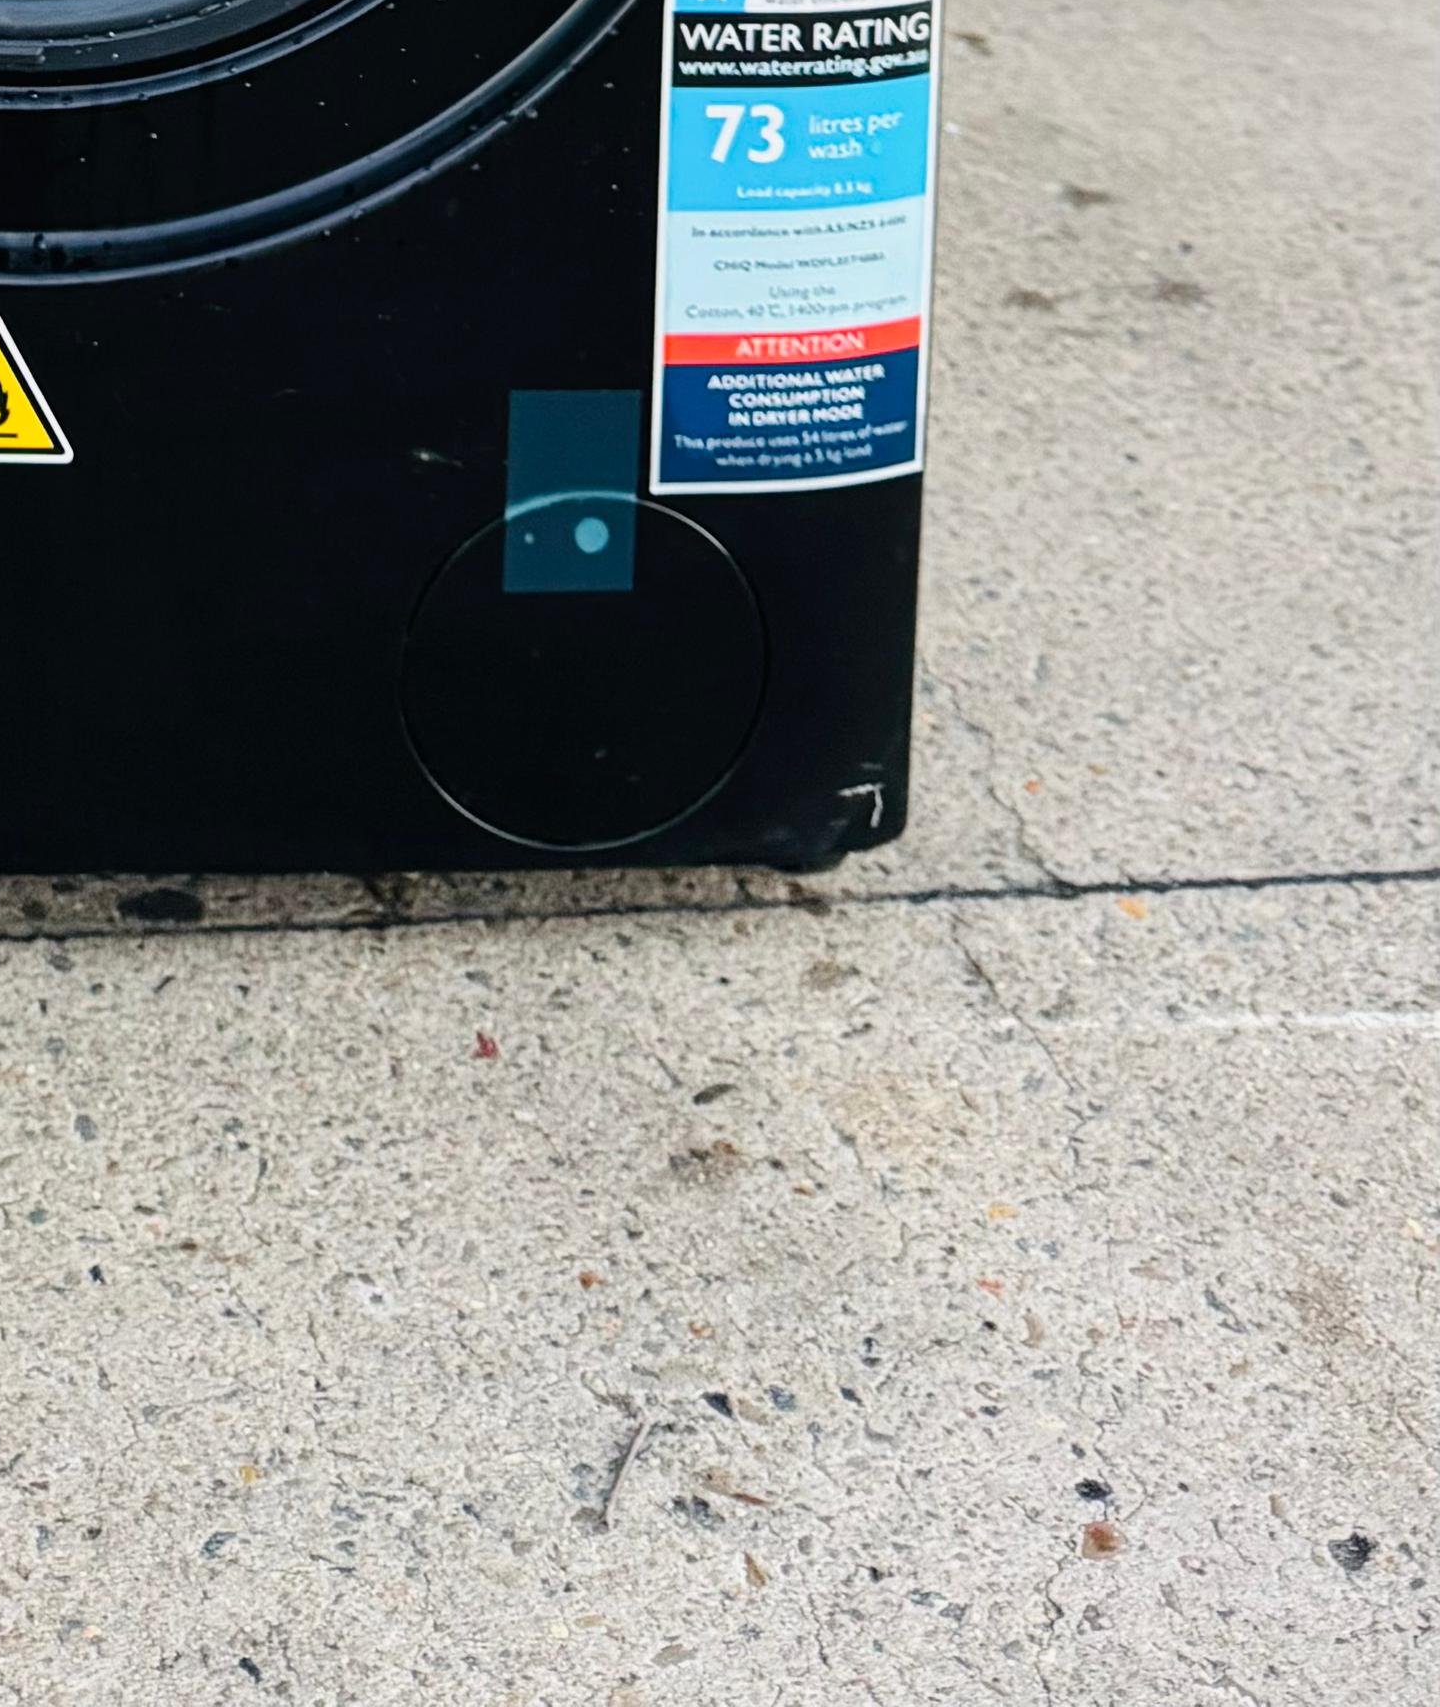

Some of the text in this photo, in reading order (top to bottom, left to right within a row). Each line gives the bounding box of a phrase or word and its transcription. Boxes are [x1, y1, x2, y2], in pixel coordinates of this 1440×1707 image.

[679, 11, 931, 53] WATER RATING
[677, 48, 929, 78] www.waterrating.gov.au
[704, 102, 786, 164] 73
[809, 109, 904, 135] litres per
[808, 137, 864, 160] wash
[735, 330, 866, 358] ATTENTION
[707, 362, 886, 391] ADDITIONAL WATER
[727, 384, 866, 410] CONSUMPTION
[727, 402, 864, 428] IN DRYER MODE
